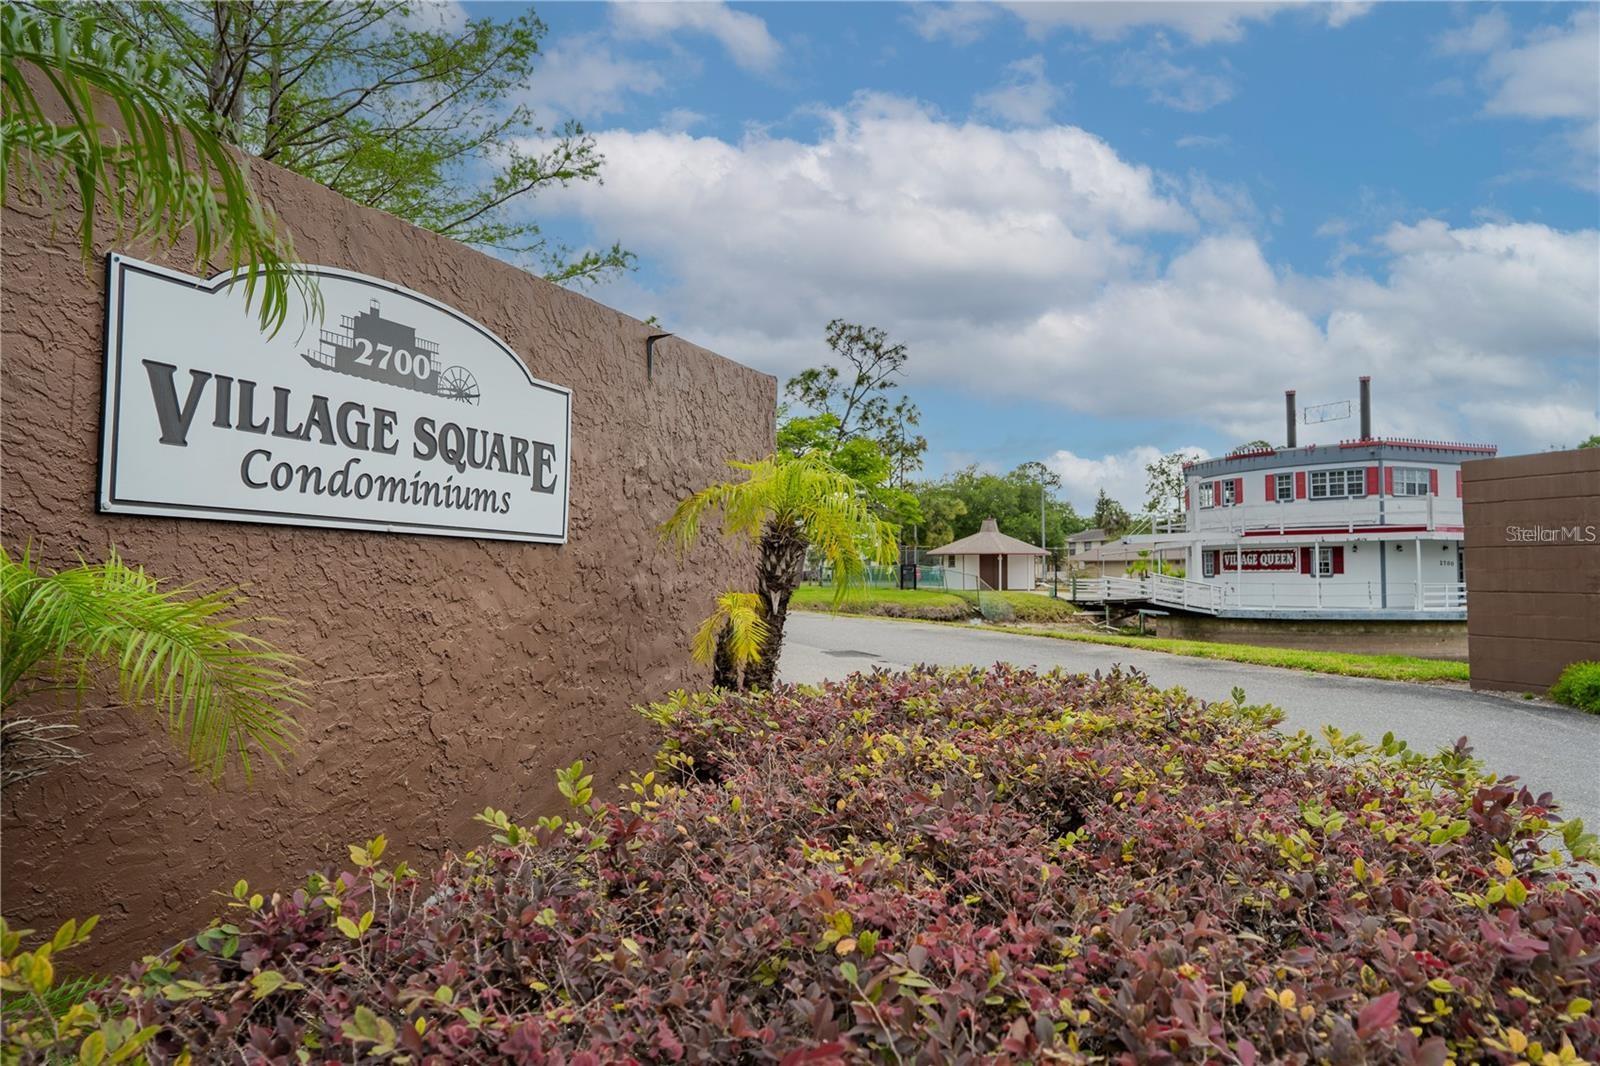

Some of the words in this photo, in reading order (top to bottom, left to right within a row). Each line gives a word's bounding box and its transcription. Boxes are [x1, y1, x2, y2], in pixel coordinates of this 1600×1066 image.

[354, 337, 431, 380] 2700
[142, 359, 400, 455] VILLAGE
[413, 416, 557, 494] SQUARE
[240, 449, 511, 514] Condominiums
[1260, 552, 1294, 567] QUEEN
